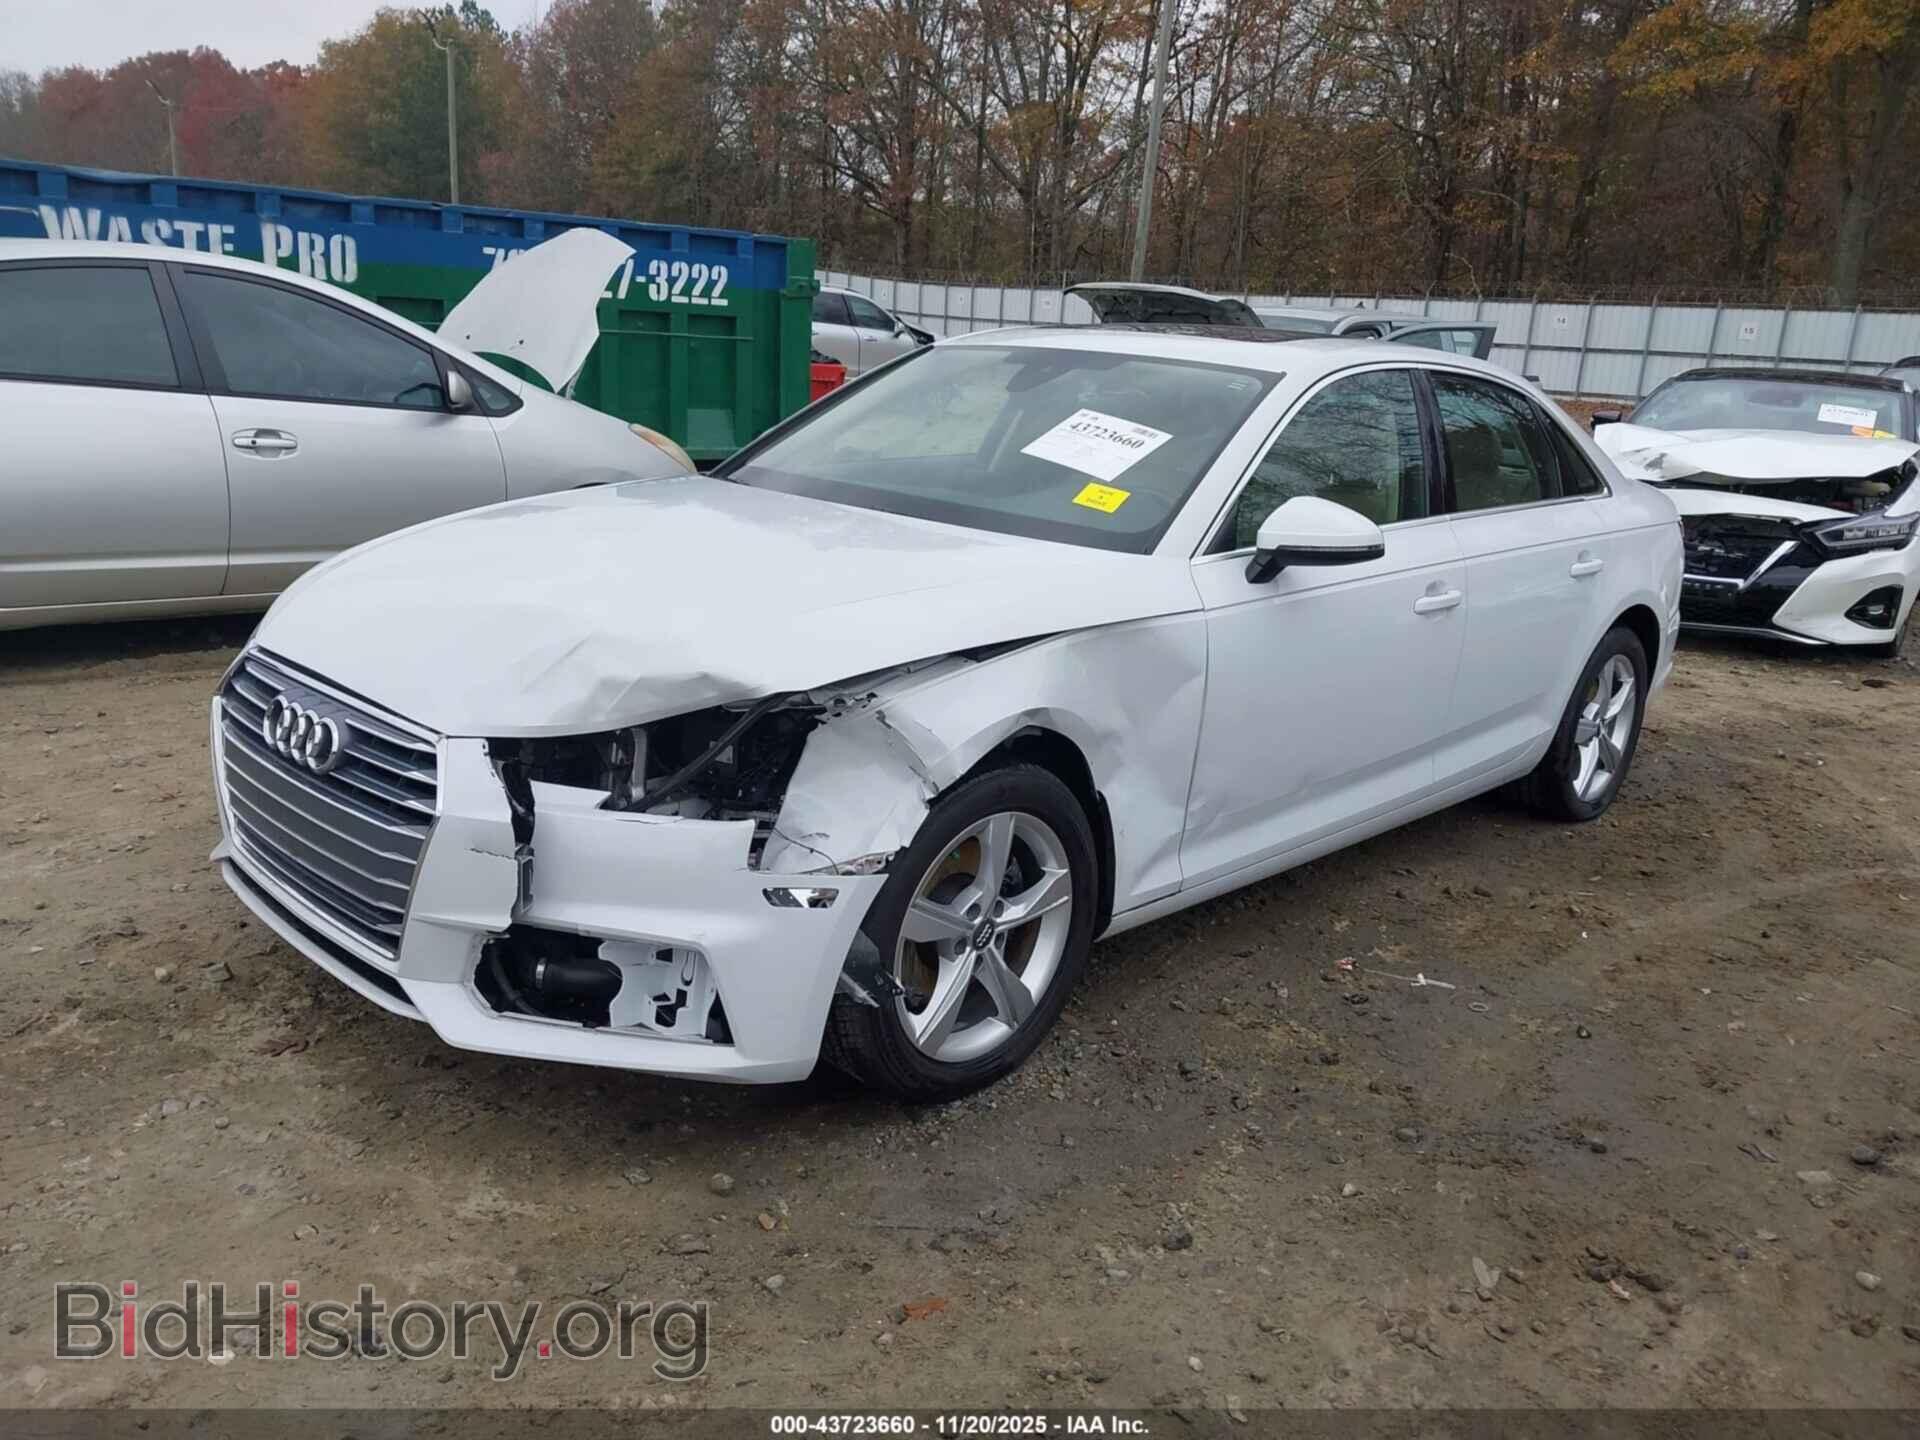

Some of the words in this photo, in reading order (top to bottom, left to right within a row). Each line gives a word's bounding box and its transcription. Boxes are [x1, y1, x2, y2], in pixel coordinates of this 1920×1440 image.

[39, 204, 235, 255] WASTE
[260, 222, 358, 283] PRO
[601, 258, 728, 306] 7-3222
[1069, 421, 1145, 449] 43723660
